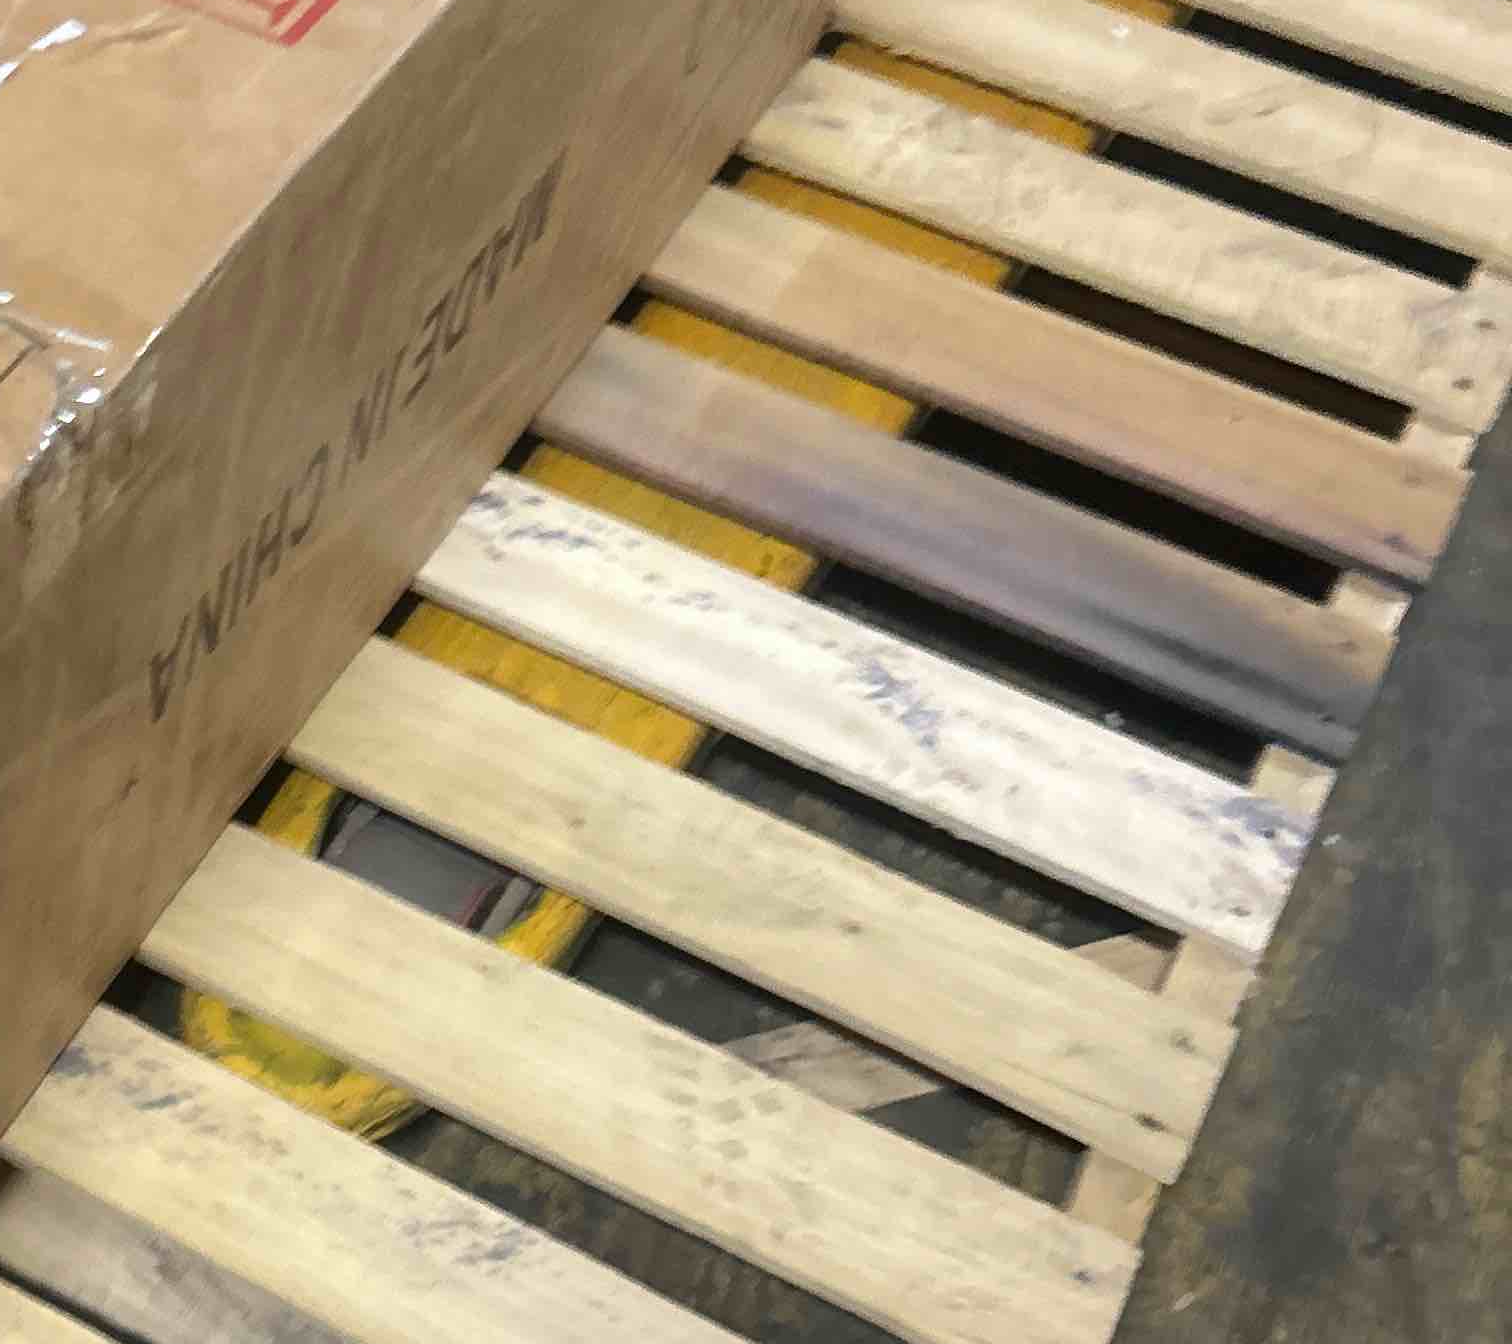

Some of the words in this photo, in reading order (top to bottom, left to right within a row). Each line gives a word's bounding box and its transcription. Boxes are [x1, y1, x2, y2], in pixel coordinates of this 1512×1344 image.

[400, 144, 568, 407] MADE
[336, 344, 408, 486] IN
[150, 441, 330, 723] CHINA
